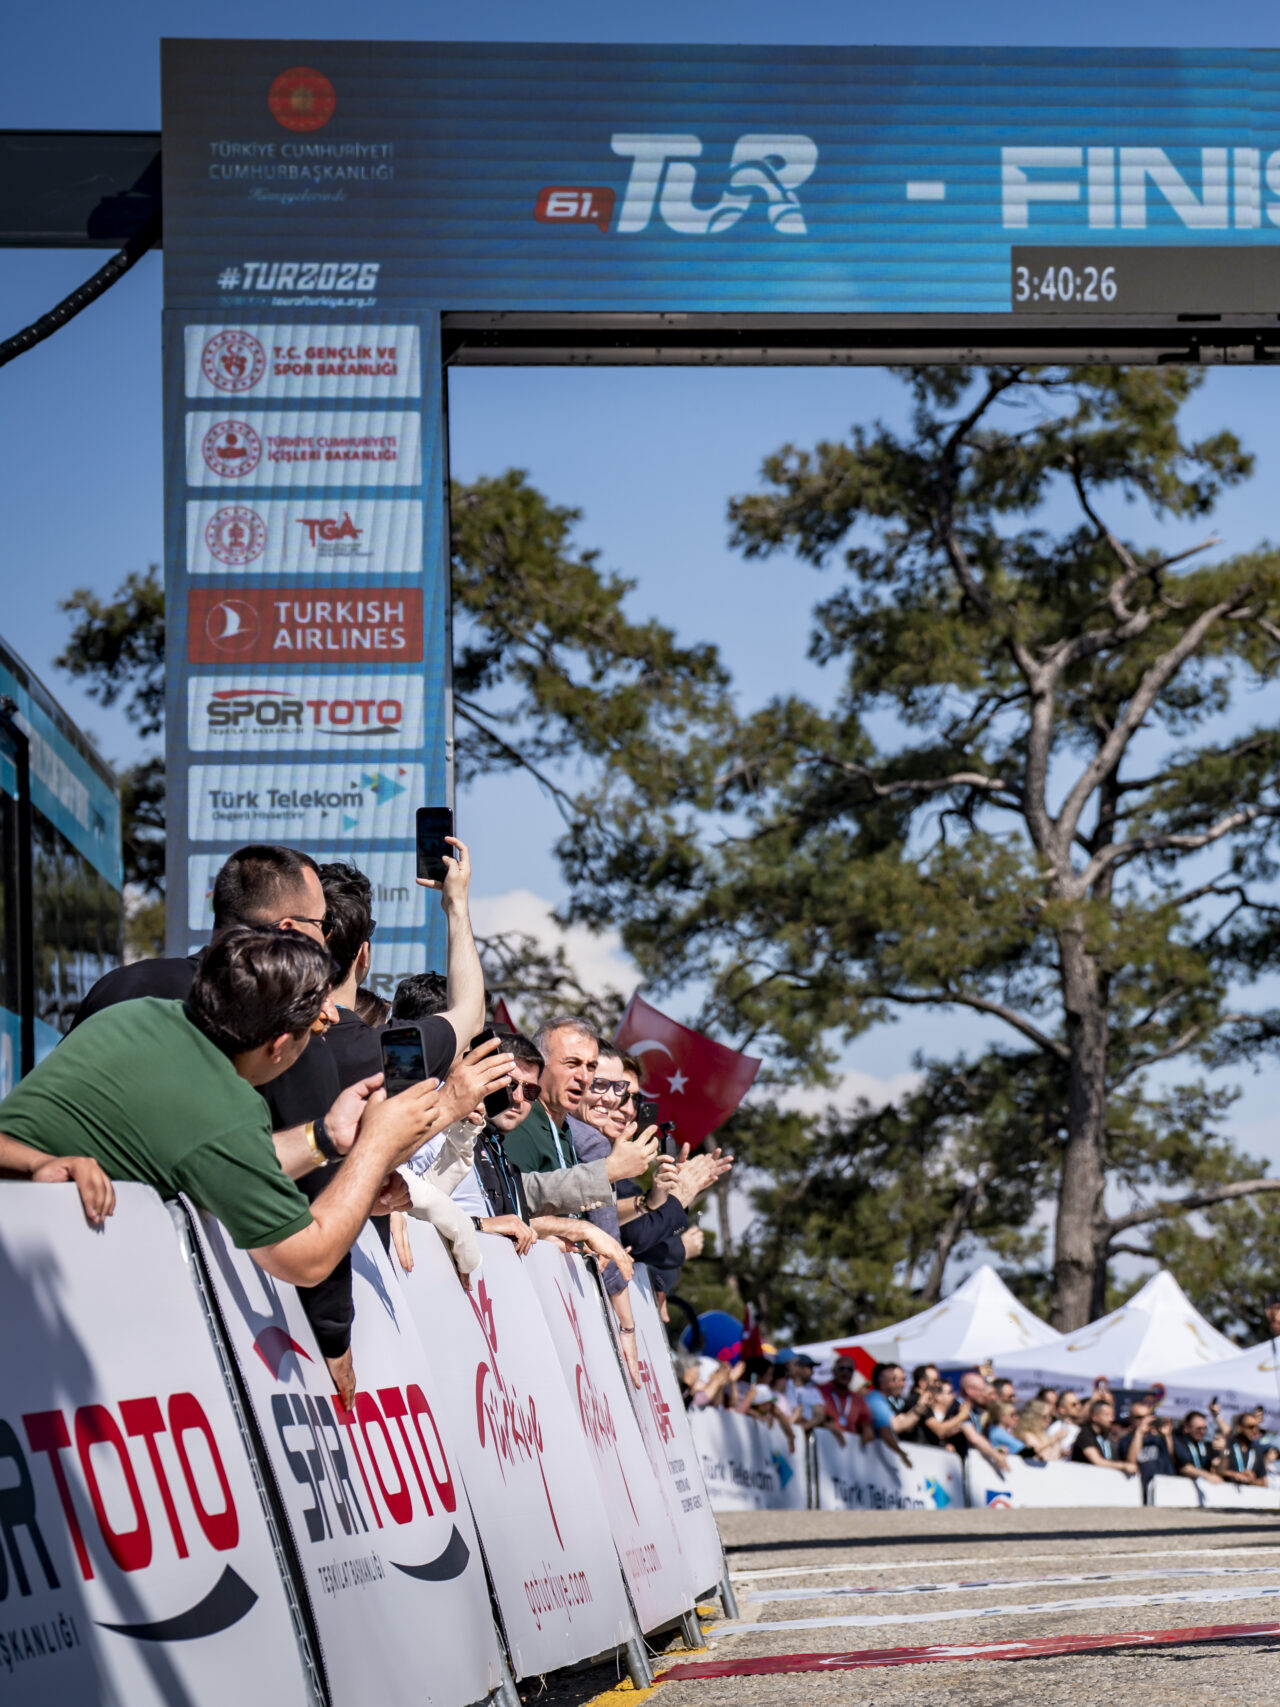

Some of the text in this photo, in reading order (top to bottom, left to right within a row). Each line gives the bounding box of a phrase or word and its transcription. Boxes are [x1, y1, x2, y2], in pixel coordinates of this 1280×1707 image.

[208, 140, 395, 158] TÜRKİYE CUMHURİYETİ
[208, 163, 395, 183] CUMHURBAŞKANLIĞI
[545, 134, 819, 233] 61. TUR
[216, 262, 381, 291] #TUR2026
[1015, 266, 1118, 301] 3:40:26
[273, 344, 397, 361] T.C. GENÇLİK VE
[273, 361, 398, 376] SPOR BAKANLIĞI
[325, 448, 398, 461] BAKANLIĞI
[296, 512, 364, 547] TGA
[273, 601, 405, 624] TURKISH
[272, 628, 407, 650] AIRLINES
[208, 789, 364, 809] Türk Telekom
[524, 1560, 593, 1631] goturkiye.com
[0, 1611, 81, 1673] ŞKANLIĞI
